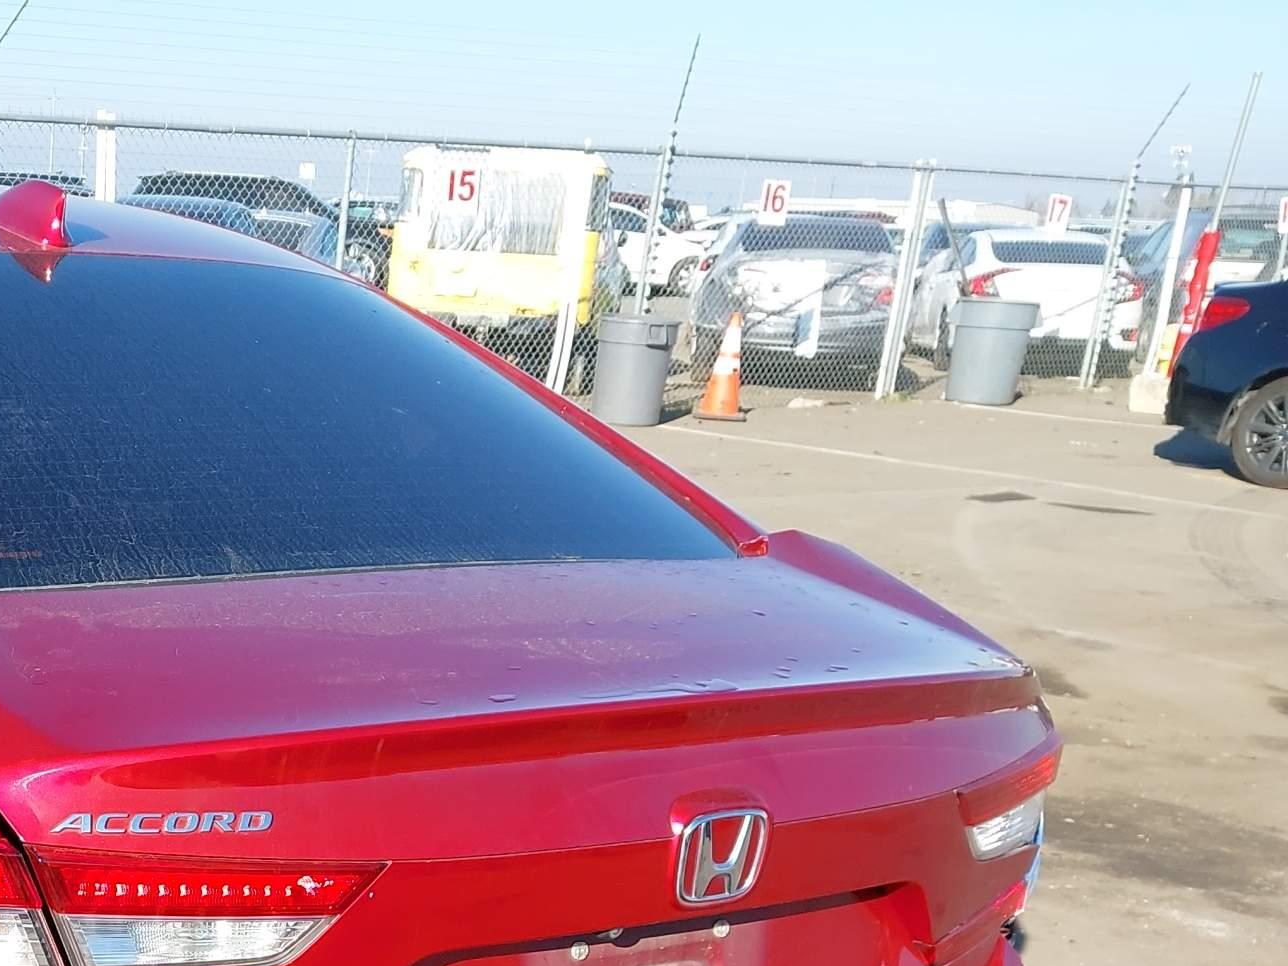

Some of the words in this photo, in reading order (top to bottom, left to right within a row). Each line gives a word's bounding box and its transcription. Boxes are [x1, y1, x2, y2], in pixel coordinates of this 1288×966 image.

[448, 170, 475, 201] 15
[763, 183, 786, 213] 16
[1048, 198, 1068, 222] 17
[50, 810, 274, 834] ACCORD
